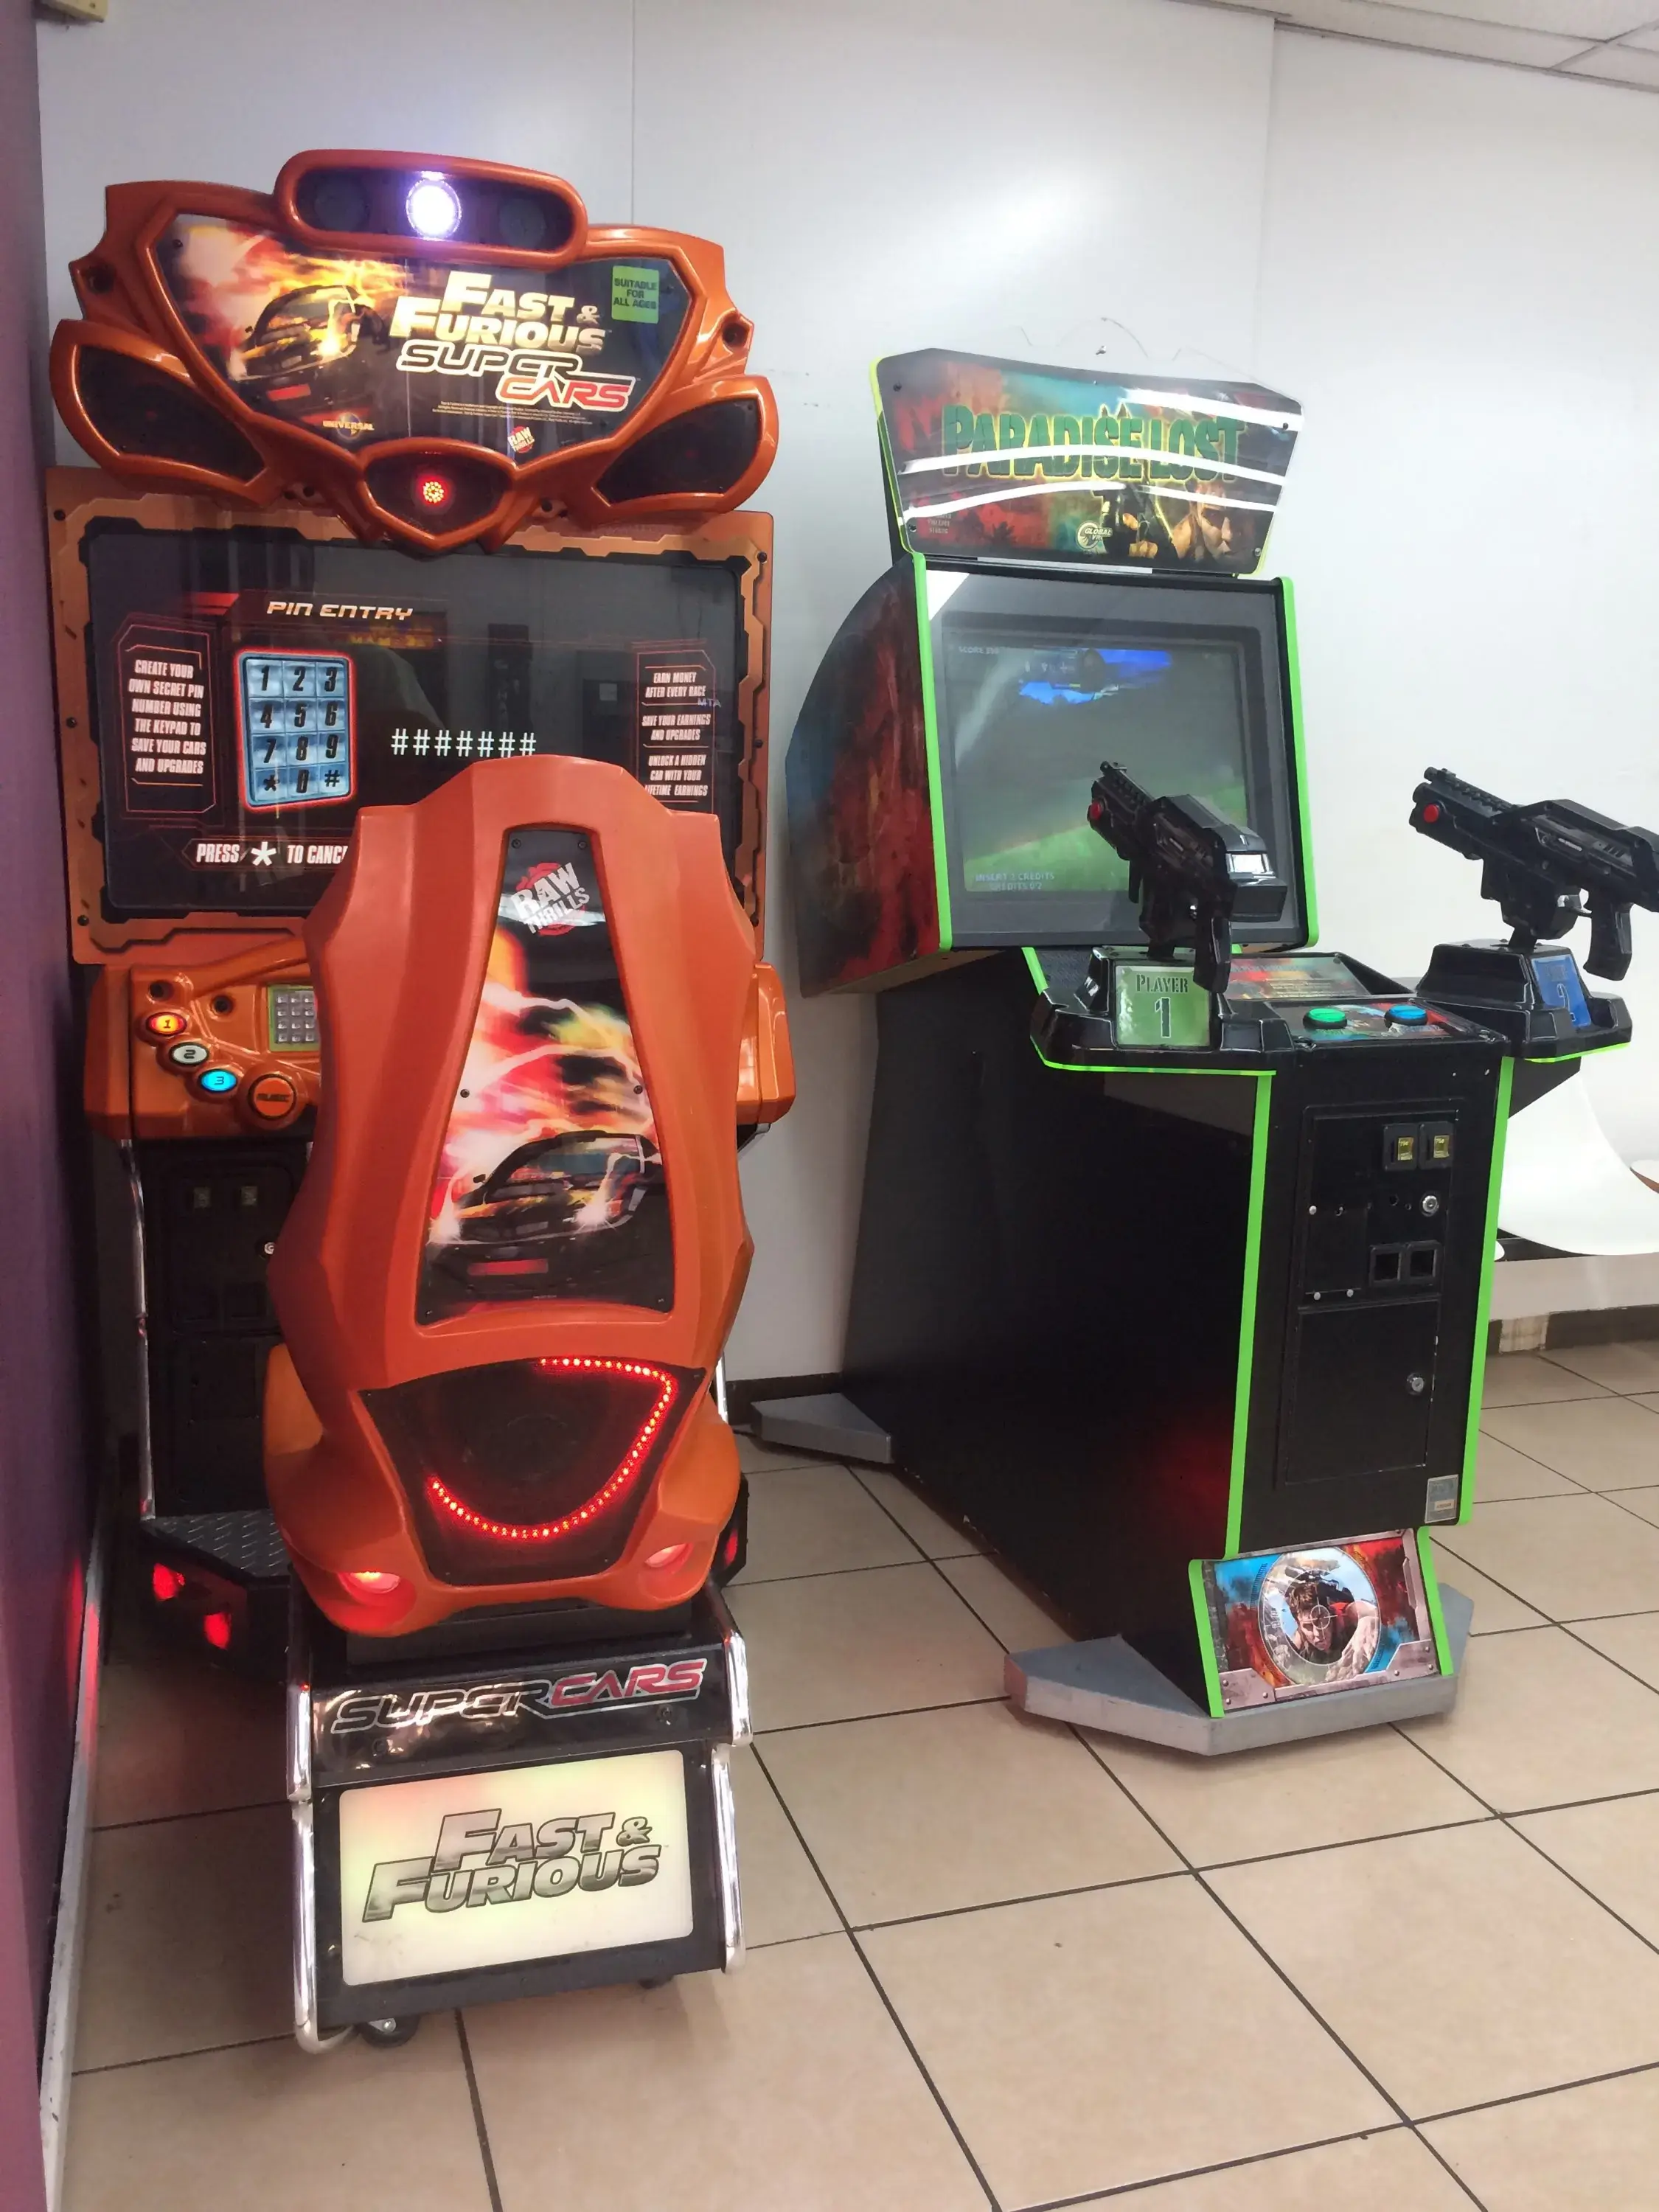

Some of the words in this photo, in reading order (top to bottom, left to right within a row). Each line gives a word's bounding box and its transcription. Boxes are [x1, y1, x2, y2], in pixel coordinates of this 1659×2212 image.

[614, 278, 658, 291] SUITABLE
[627, 289, 644, 298] FOR
[441, 271, 574, 321] FAST
[577, 305, 600, 324] &
[613, 297, 629, 307] ALL
[632, 299, 657, 309] AGES
[389, 295, 606, 356] FURIOUS
[396, 338, 582, 379] SUPER
[495, 376, 636, 412] CARS
[507, 427, 532, 447] RAW
[942, 403, 1143, 480] PARADISE
[1150, 415, 1247, 482] LOST
[266, 601, 313, 616] PIN
[319, 604, 413, 621] ENTRY
[134, 659, 167, 676] CREATE
[170, 663, 194, 679] YOUR
[261, 665, 270, 691] 1
[292, 666, 306, 692] 2
[324, 667, 338, 692] 3
[653, 672, 671, 684] EARN
[672, 672, 697, 684] MONEY
[128, 678, 151, 695] OWN
[153, 681, 186, 698] SECRET
[187, 684, 204, 699] PIN
[644, 686, 666, 698] AFTER
[667, 686, 687, 698] EVERY
[689, 685, 706, 698] RACE
[131, 698, 172, 715] NUMBER
[173, 701, 201, 717] USING
[260, 703, 273, 728] 4
[294, 702, 307, 728] 5
[324, 700, 339, 726] 6
[134, 717, 152, 733] THE
[153, 719, 188, 736] KEYPAD
[189, 722, 201, 736] TO
[641, 715, 657, 726] SAVE
[658, 714, 676, 726] YOUR
[676, 714, 711, 726] EARNINGS
[650, 729, 665, 741] AND
[666, 728, 700, 740] UPGRADES
[131, 737, 155, 753] SAVE
[156, 739, 181, 754] YOUR
[183, 740, 206, 756] CARS
[263, 738, 276, 763] 7
[296, 736, 309, 761] 8
[325, 734, 339, 759] 9
[135, 757, 156, 773] AND
[157, 759, 204, 774] UPGRADES
[648, 754, 674, 767] UNLOCK
[674, 755, 680, 766] A
[681, 754, 707, 766] HIDDEN
[296, 769, 310, 794] 0
[650, 770, 664, 782] CAR
[664, 770, 682, 782] WITH
[684, 769, 702, 781] YOUR
[674, 785, 709, 796] EARNINGS
[195, 843, 240, 863] PRESS
[287, 845, 305, 864] TO
[510, 862, 580, 919] RAW
[519, 887, 590, 934] THRILLS
[1136, 974, 1188, 993] PLAYER
[163, 1019, 171, 1029] 1
[1155, 996, 1172, 1039] 1
[184, 1048, 196, 1060] 2
[214, 1076, 225, 1086] 3
[433, 1808, 616, 1874] FAST
[616, 1816, 653, 1847] &
[362, 1844, 662, 1923] FURIOUS
